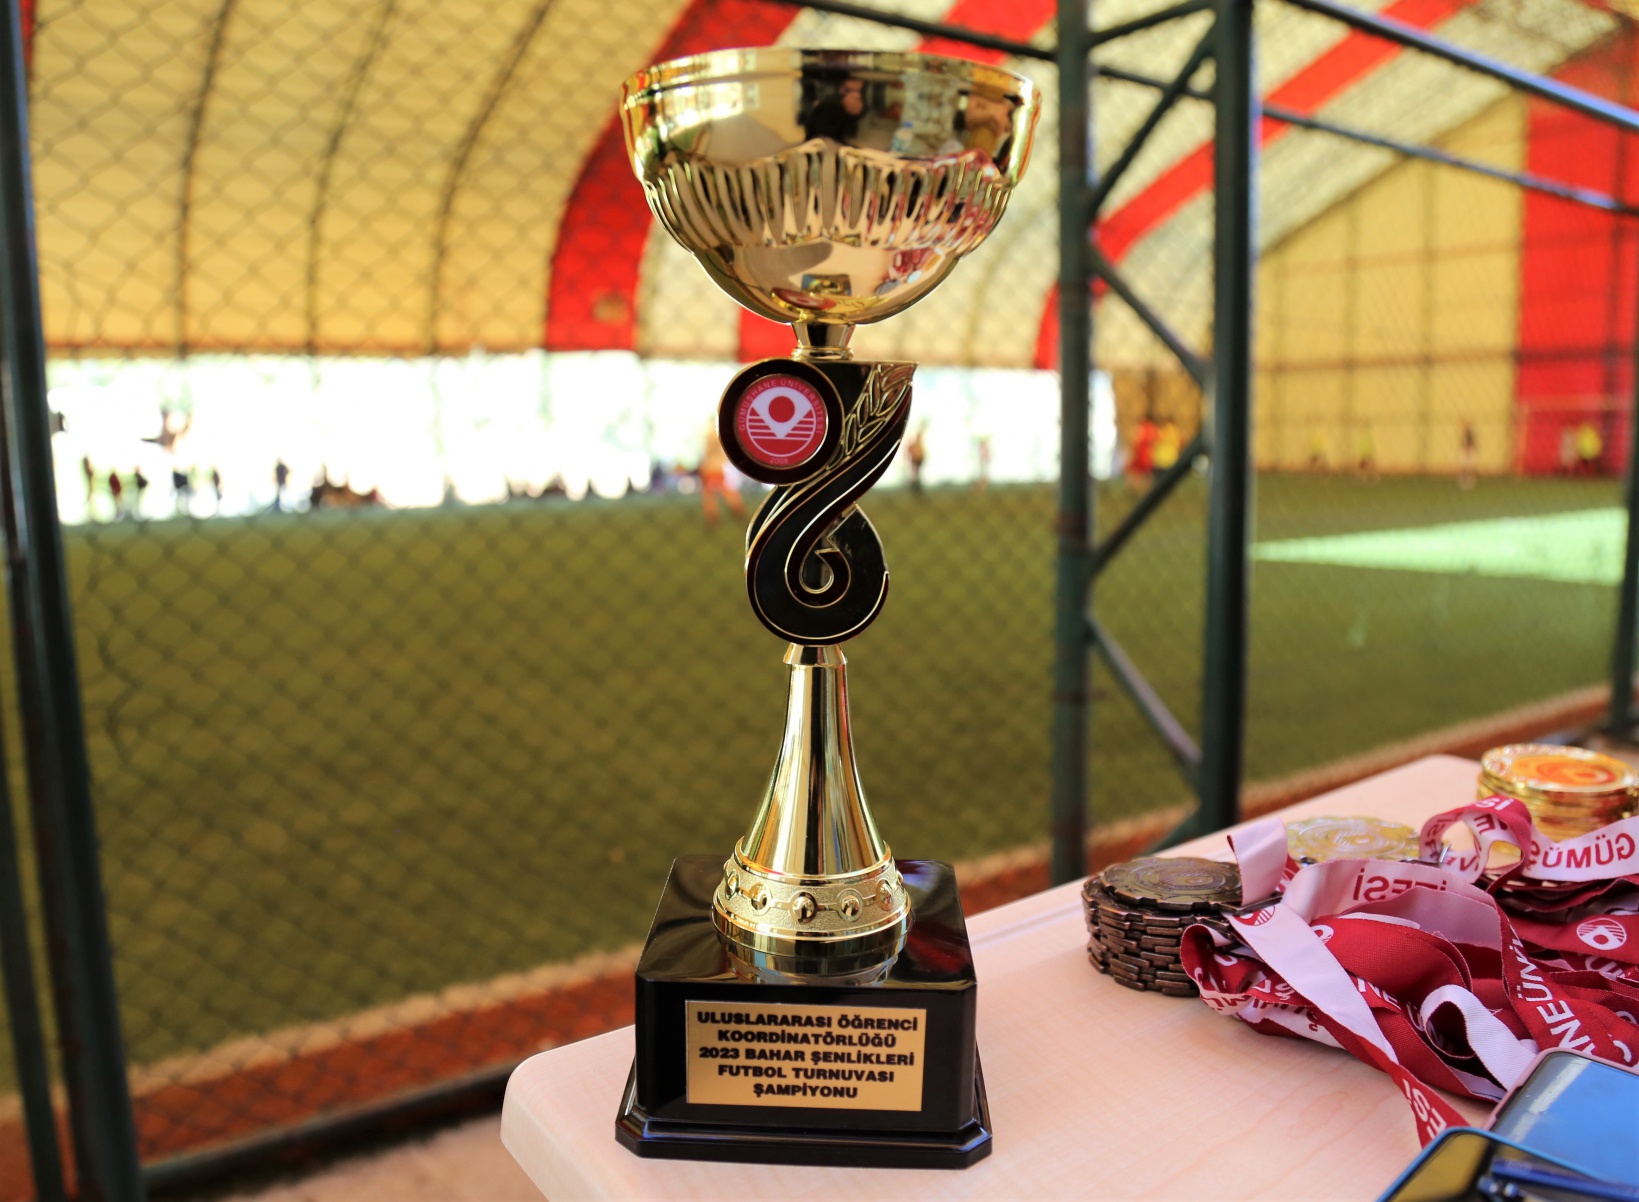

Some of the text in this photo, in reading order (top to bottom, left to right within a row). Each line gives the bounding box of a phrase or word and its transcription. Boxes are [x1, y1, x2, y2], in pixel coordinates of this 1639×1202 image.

[697, 1011, 918, 1031] ULUSLARARASI ÖĞRENCİ
[718, 1029, 897, 1048] KOORDİNATÖRLÜĞÜ
[699, 1046, 915, 1066] 2023 BAHAR ŞENLİKLERİ
[718, 1064, 895, 1082] FUTBOL TURNUVASI
[753, 1083, 858, 1099] ŞAMPİYONU
